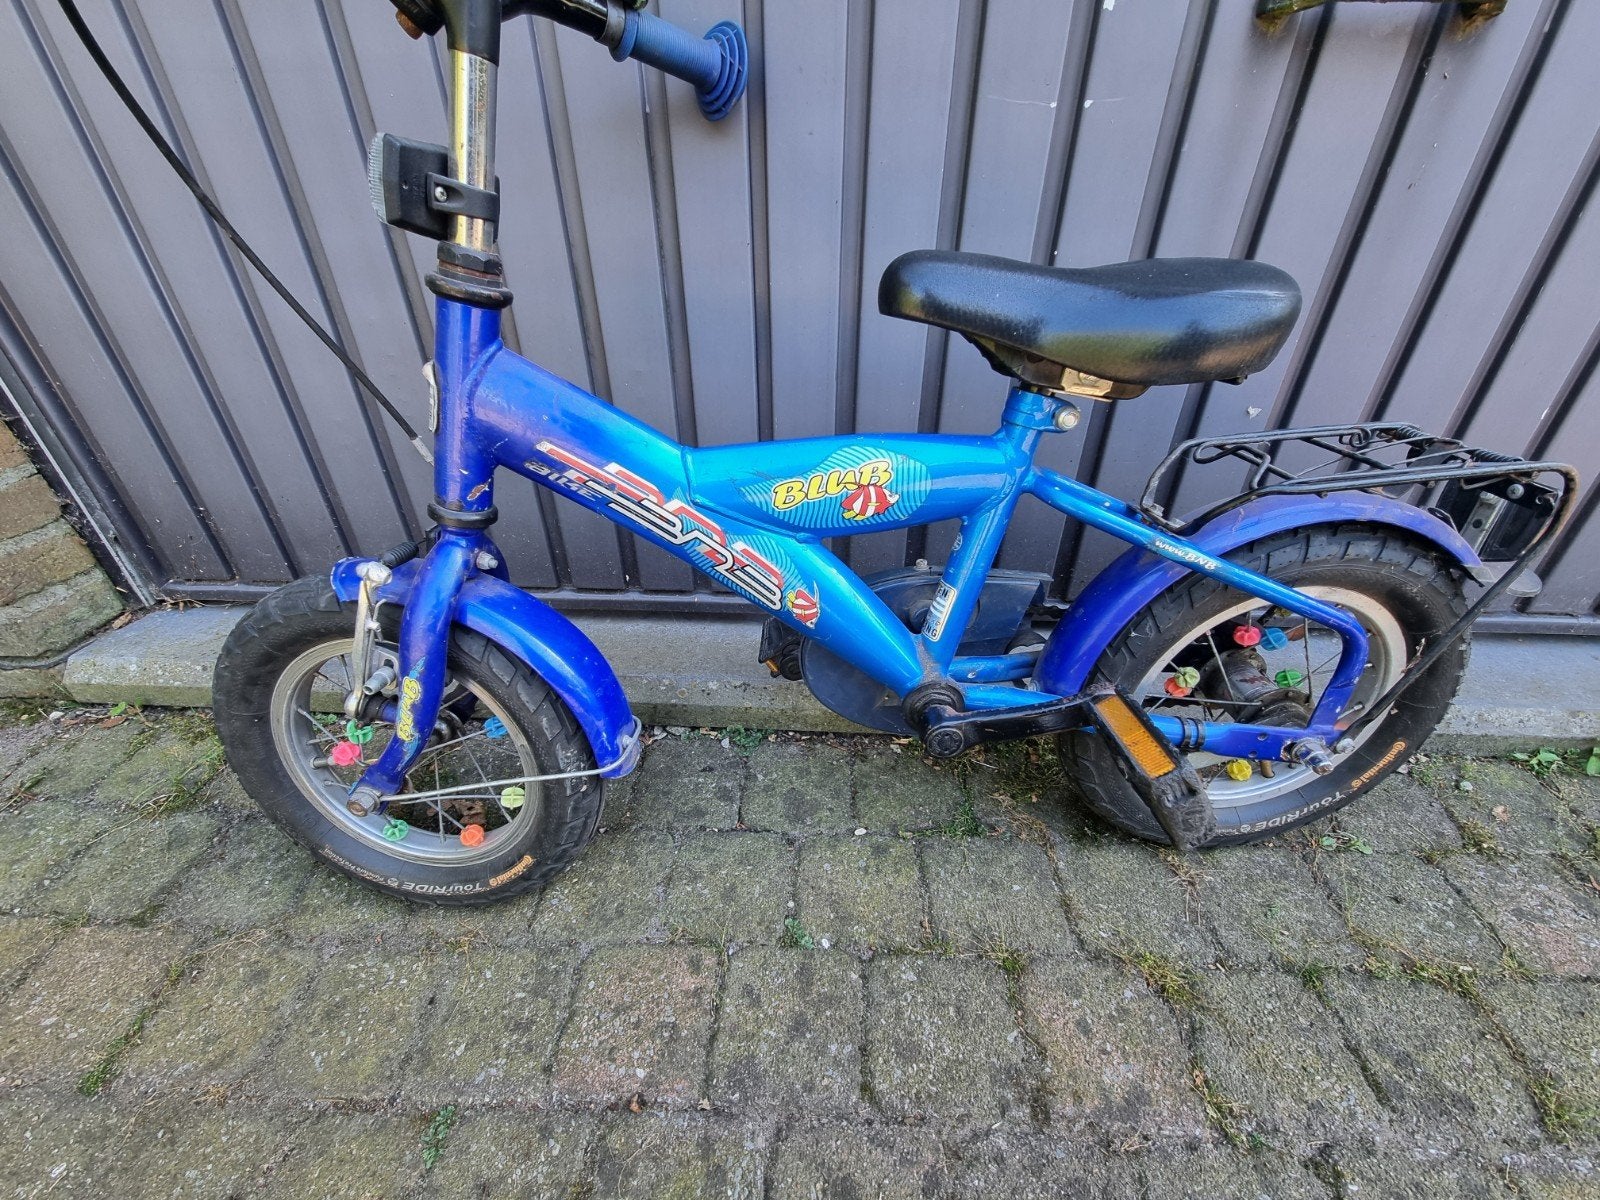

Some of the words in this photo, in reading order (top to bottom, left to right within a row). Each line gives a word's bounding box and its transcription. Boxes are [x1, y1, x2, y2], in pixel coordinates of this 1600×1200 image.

[772, 459, 893, 511] BLUB
[1359, 741, 1407, 783] Continental
[497, 855, 535, 884] Continental
